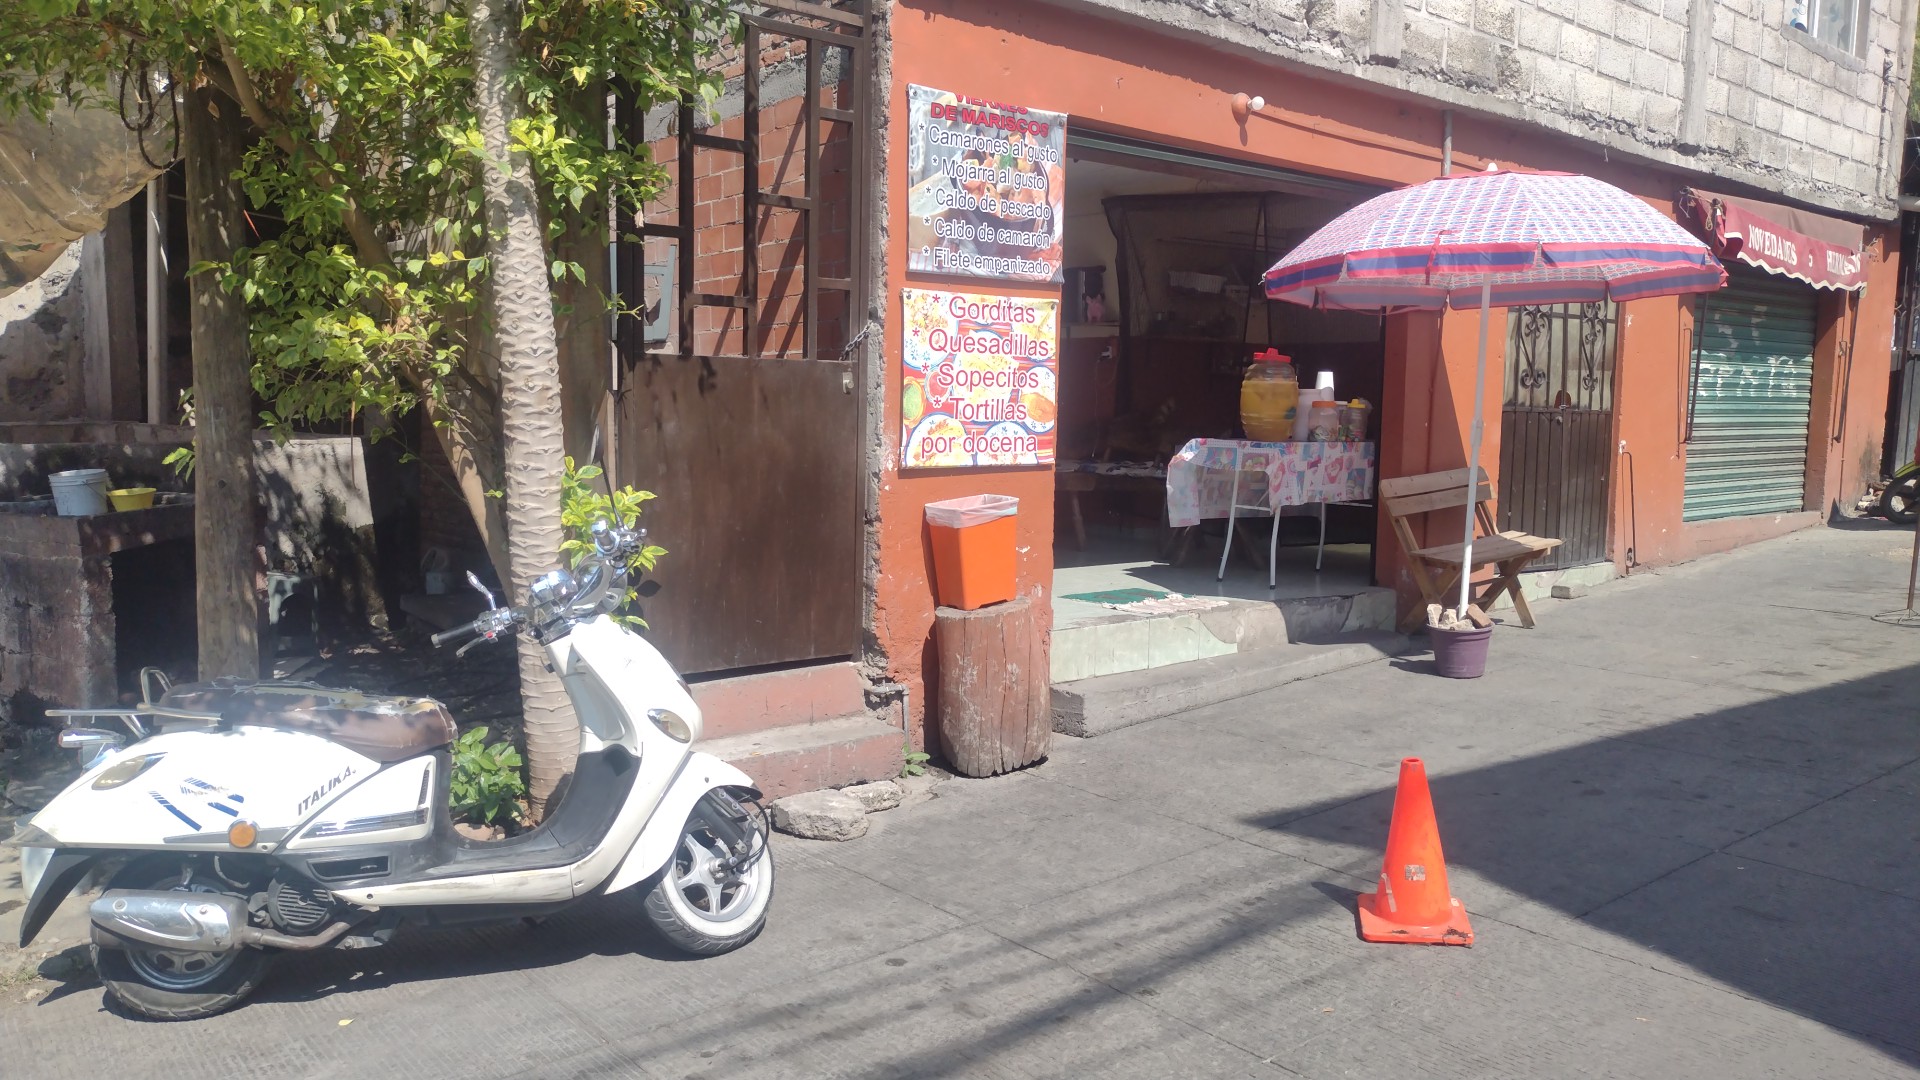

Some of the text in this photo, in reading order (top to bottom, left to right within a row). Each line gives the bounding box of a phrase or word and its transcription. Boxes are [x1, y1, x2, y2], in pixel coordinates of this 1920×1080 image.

[931, 102, 1049, 138] DE MARISCOS
[929, 126, 1057, 164] Camarones al gusto
[942, 158, 1045, 190] Mojarra al gusto
[935, 188, 1051, 219] Caldo de pescado
[935, 218, 1051, 248] Caldo de camarón
[934, 248, 1051, 275] Filete empanizado
[949, 295, 1036, 324] Gorditas
[928, 328, 1049, 357] Quesadillas
[937, 363, 1040, 392] Sopecitos
[949, 398, 1028, 421] Tortillas
[921, 431, 1038, 459] por docena
[298, 765, 352, 816] ITALIKA
